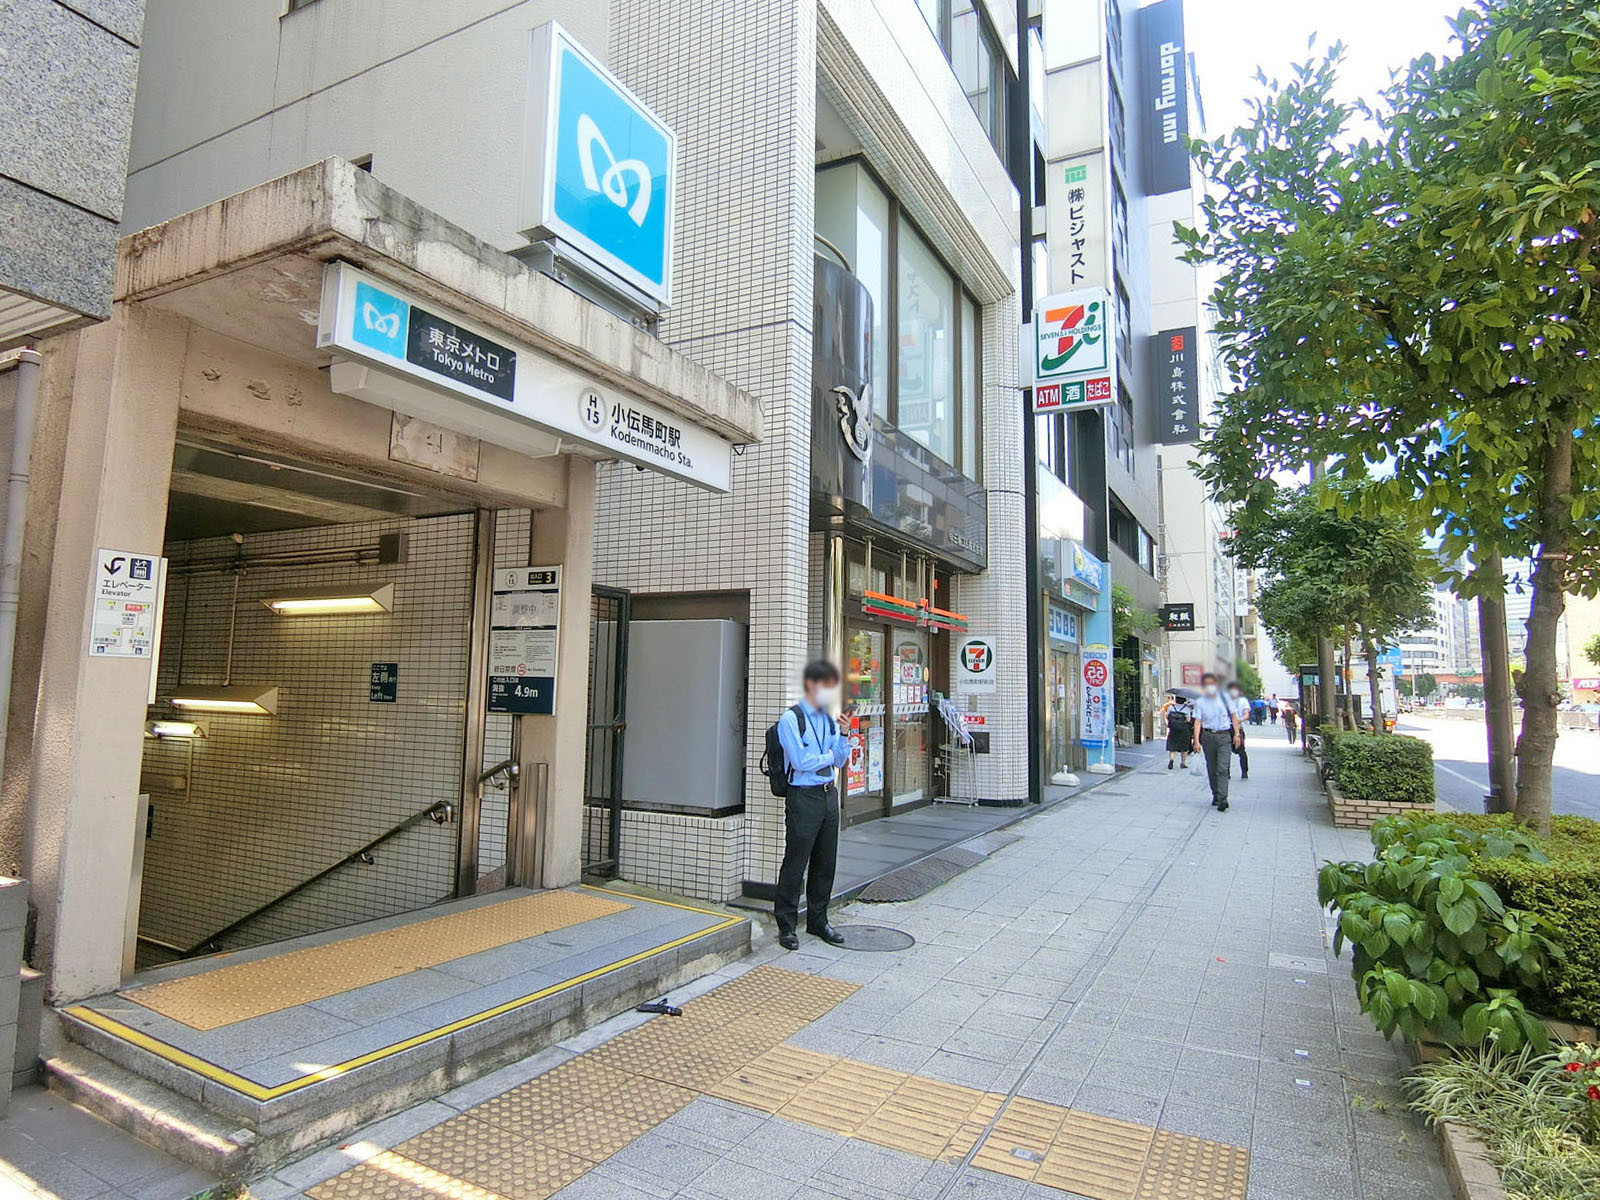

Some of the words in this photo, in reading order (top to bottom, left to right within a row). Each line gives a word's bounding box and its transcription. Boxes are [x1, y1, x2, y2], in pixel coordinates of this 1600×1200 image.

[1155, 41, 1181, 111] dormy
[1162, 112, 1178, 144] inn
[1068, 324, 1102, 336] HOLDINGS
[428, 326, 500, 371] 東京メトロ
[432, 348, 464, 374] Tokyo
[465, 362, 495, 384] Metro
[1037, 388, 1059, 405] ATM
[1066, 384, 1080, 402] 酒
[1087, 380, 1110, 398] たばこ
[588, 394, 597, 409] H
[585, 408, 600, 425] 15
[611, 402, 682, 448] 小伝馬町駅
[610, 425, 676, 463] Kodemmacho
[677, 451, 694, 469] Sta.
[102, 579, 152, 591] エレベーター
[545, 572, 552, 583] 3
[101, 589, 131, 597] Elevator
[514, 684, 538, 698] 4.9m
